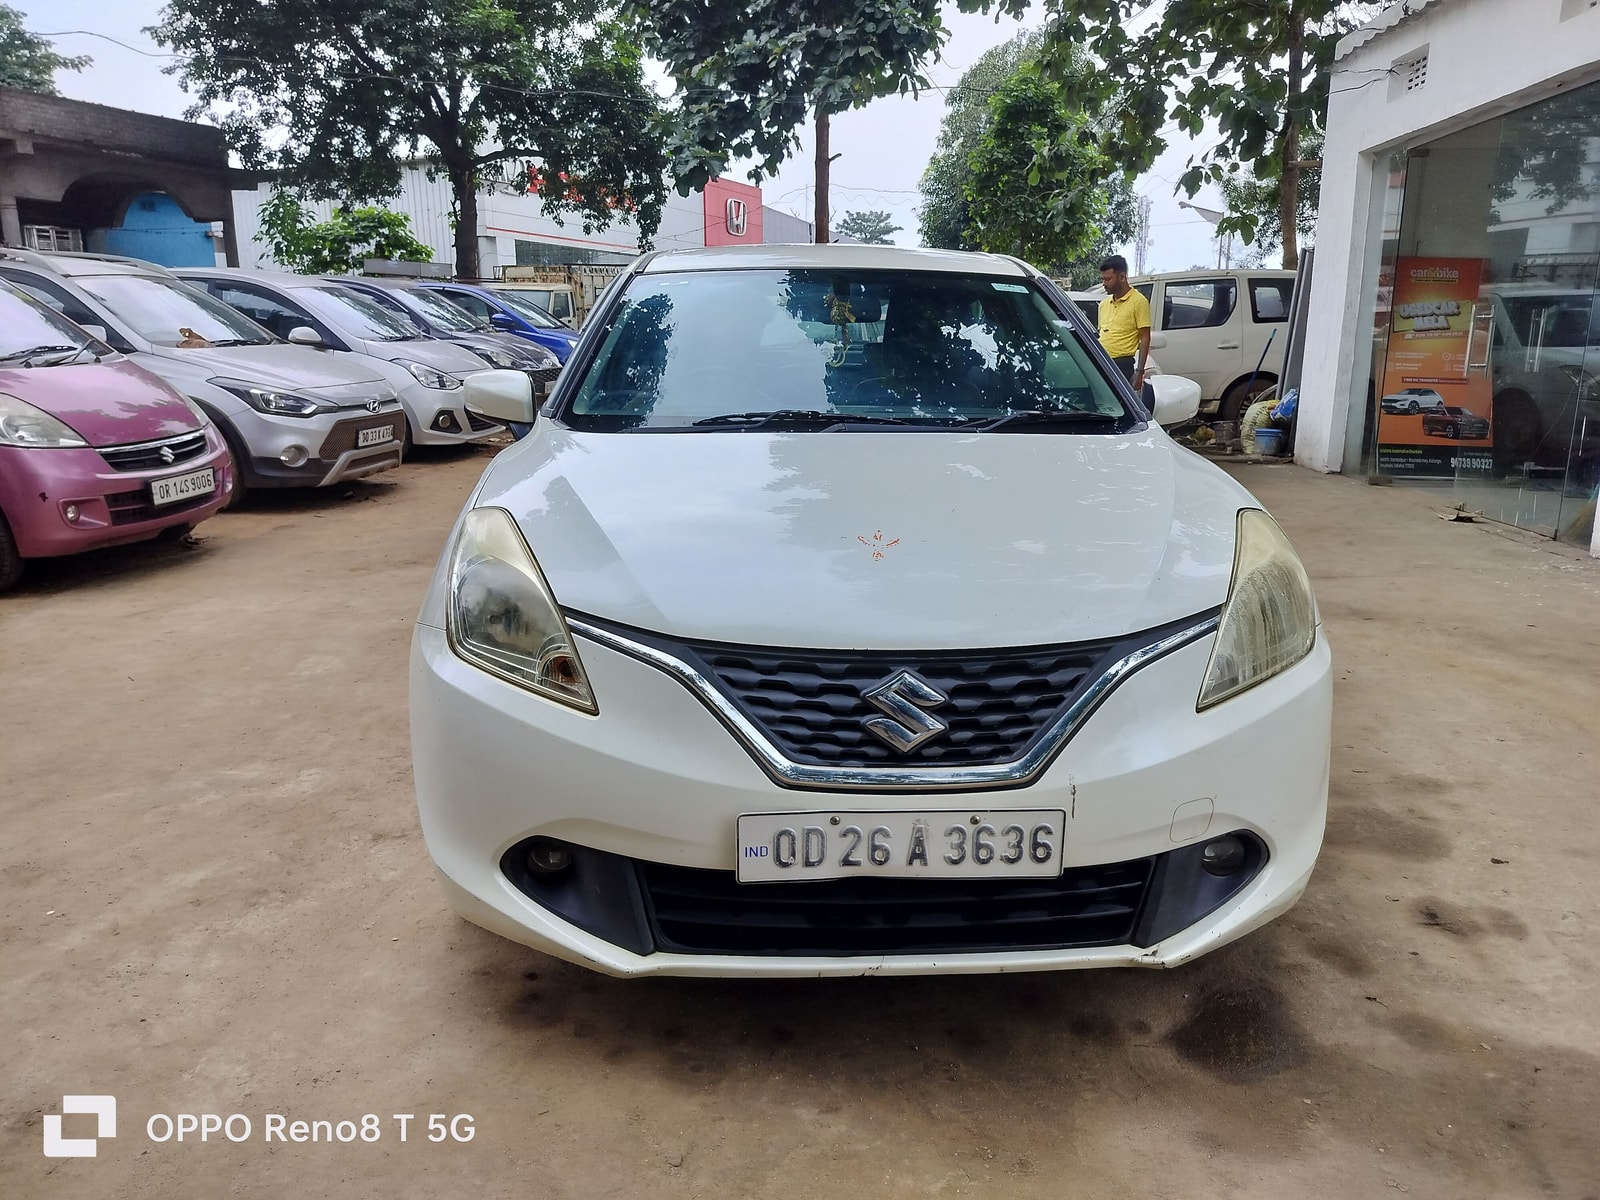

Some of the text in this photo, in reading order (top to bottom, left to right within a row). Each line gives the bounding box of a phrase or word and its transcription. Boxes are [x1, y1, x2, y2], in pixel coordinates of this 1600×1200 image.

[1410, 267, 1459, 278] car&bike
[159, 484, 171, 499] OR
[190, 474, 212, 491] 9006
[745, 846, 769, 858] IND
[839, 825, 892, 867] 26
[906, 824, 929, 866] A
[943, 823, 1054, 865] 3636
